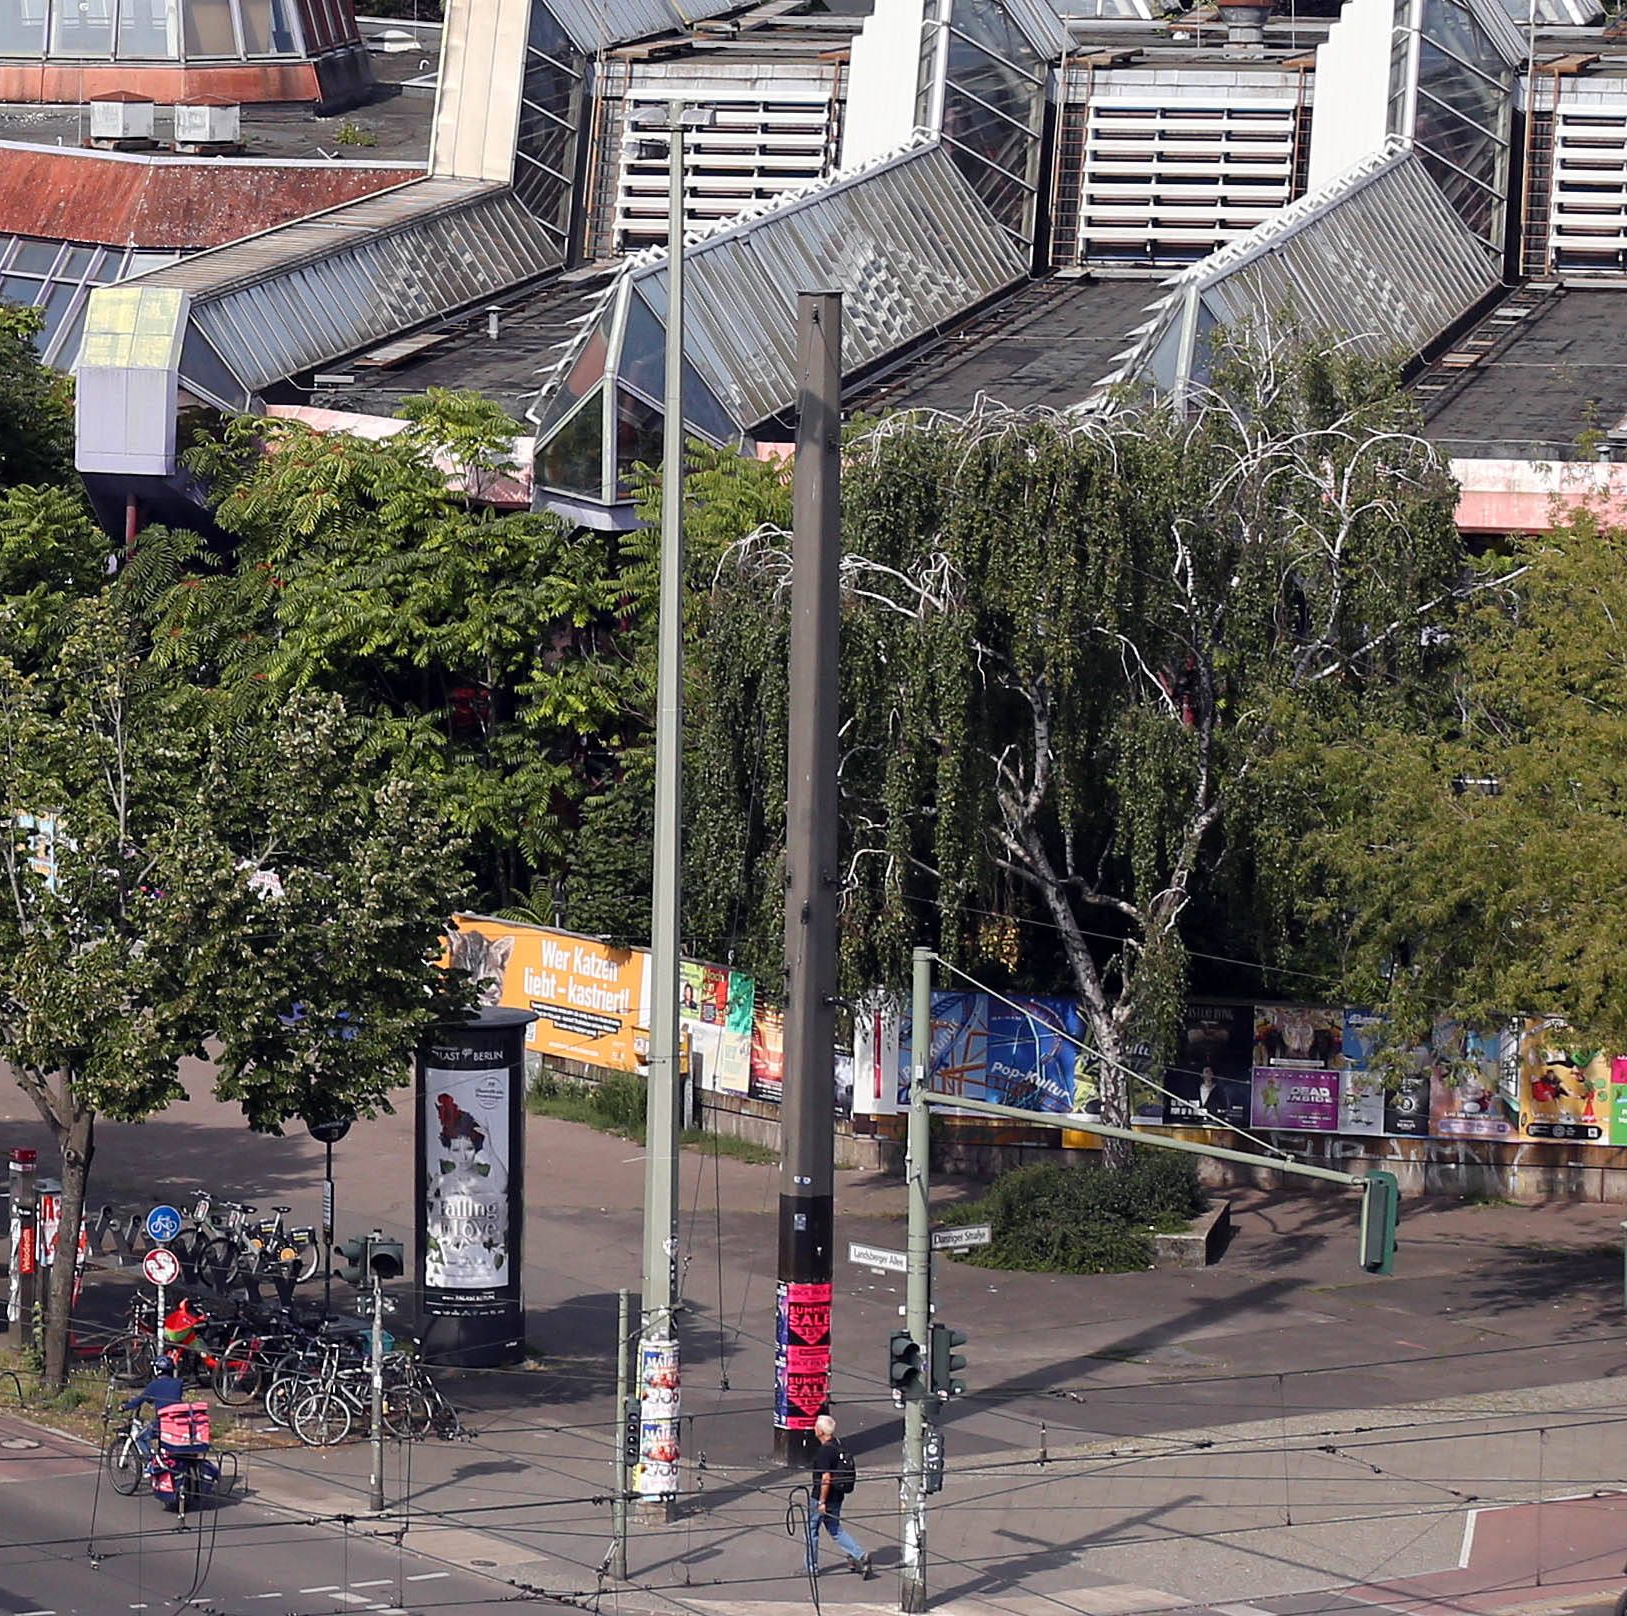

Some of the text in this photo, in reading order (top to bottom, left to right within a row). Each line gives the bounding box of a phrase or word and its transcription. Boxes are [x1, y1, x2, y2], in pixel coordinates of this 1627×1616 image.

[541, 940, 618, 982] Wer Katzen
[524, 968, 556, 998] liebt
[568, 982, 631, 1016] kastriert!
[473, 1050, 504, 1062] BERLIN
[991, 1061, 1069, 1099] Pop-Kultur
[1290, 1086, 1331, 1098] DEAD
[934, 1233, 963, 1246] Danziger
[853, 1247, 904, 1268] Landsberger Allee
[789, 1314, 830, 1326] SALE
